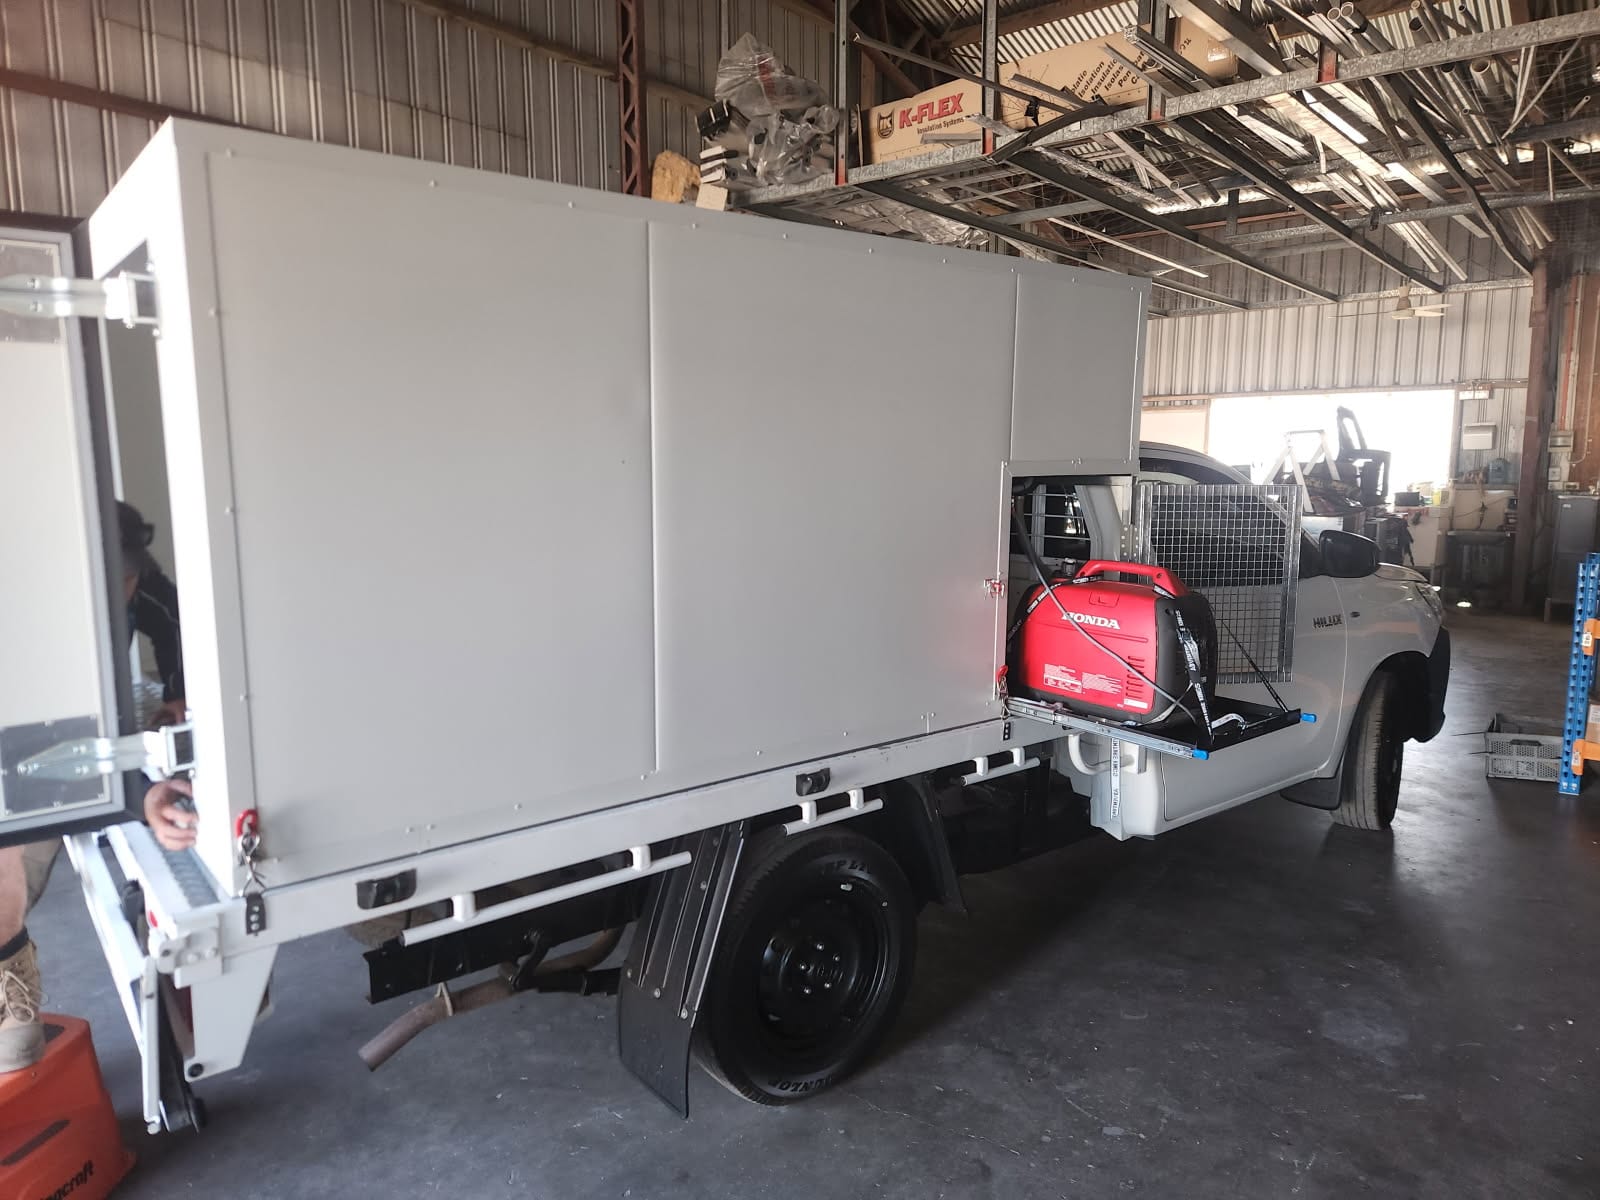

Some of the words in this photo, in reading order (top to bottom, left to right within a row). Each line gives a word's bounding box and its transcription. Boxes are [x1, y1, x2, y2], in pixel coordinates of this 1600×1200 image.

[1078, 61, 1105, 98] Isolation
[899, 92, 964, 129] K-FLEX
[917, 123, 943, 135] Insulation
[943, 117, 965, 129] Systems
